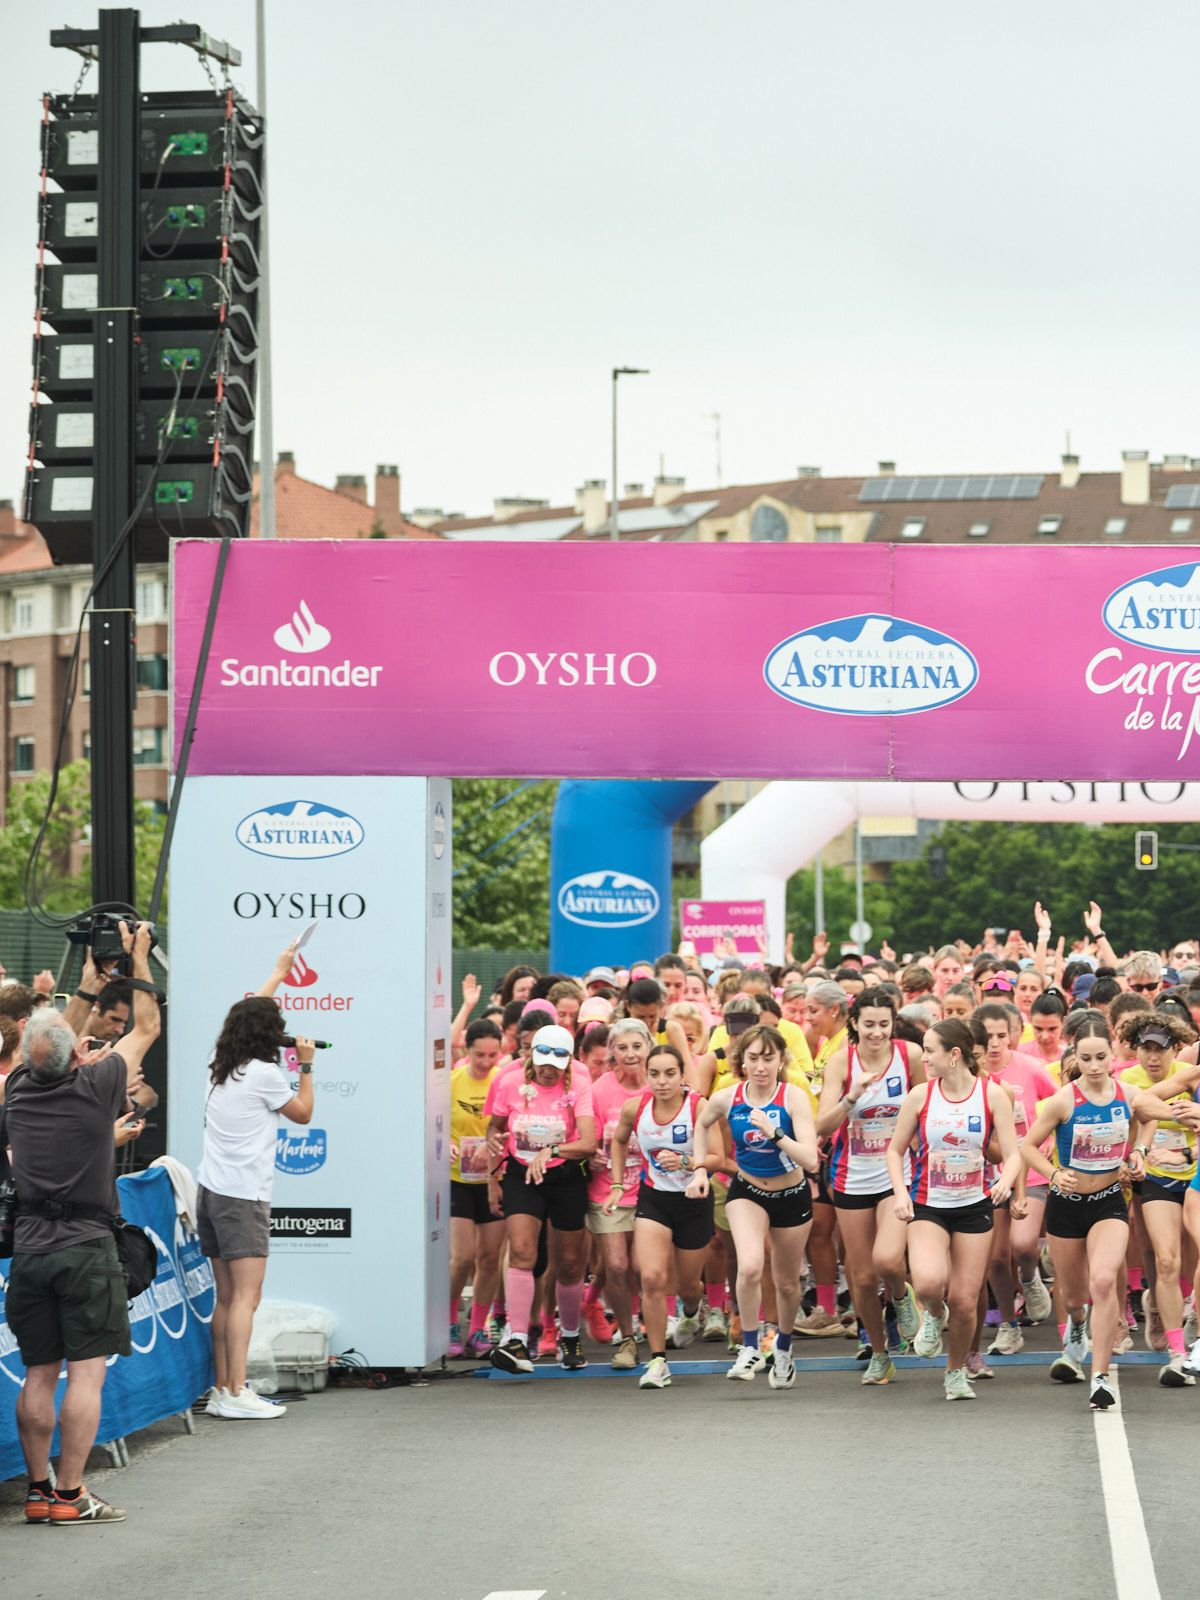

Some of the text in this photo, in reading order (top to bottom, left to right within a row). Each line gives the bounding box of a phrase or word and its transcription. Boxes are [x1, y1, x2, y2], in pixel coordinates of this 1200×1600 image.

[814, 649, 881, 659] CENTRAL
[221, 659, 383, 688] Santander
[489, 651, 658, 687] OYSHO
[781, 651, 962, 689] ASTURIANA
[1124, 696, 1184, 732] de la
[246, 822, 354, 844] ASTURIANA
[233, 891, 366, 919] OYSHO
[564, 889, 653, 914] ASTURIANA
[313, 1081, 359, 1097] nergy
[864, 1139, 886, 1149] 016
[1090, 1144, 1112, 1154] 016
[945, 1172, 967, 1182] 016
[747, 1185, 782, 1199] NIKE
[1087, 1183, 1120, 1202] NIKE
[268, 1215, 345, 1235] eutrogena
